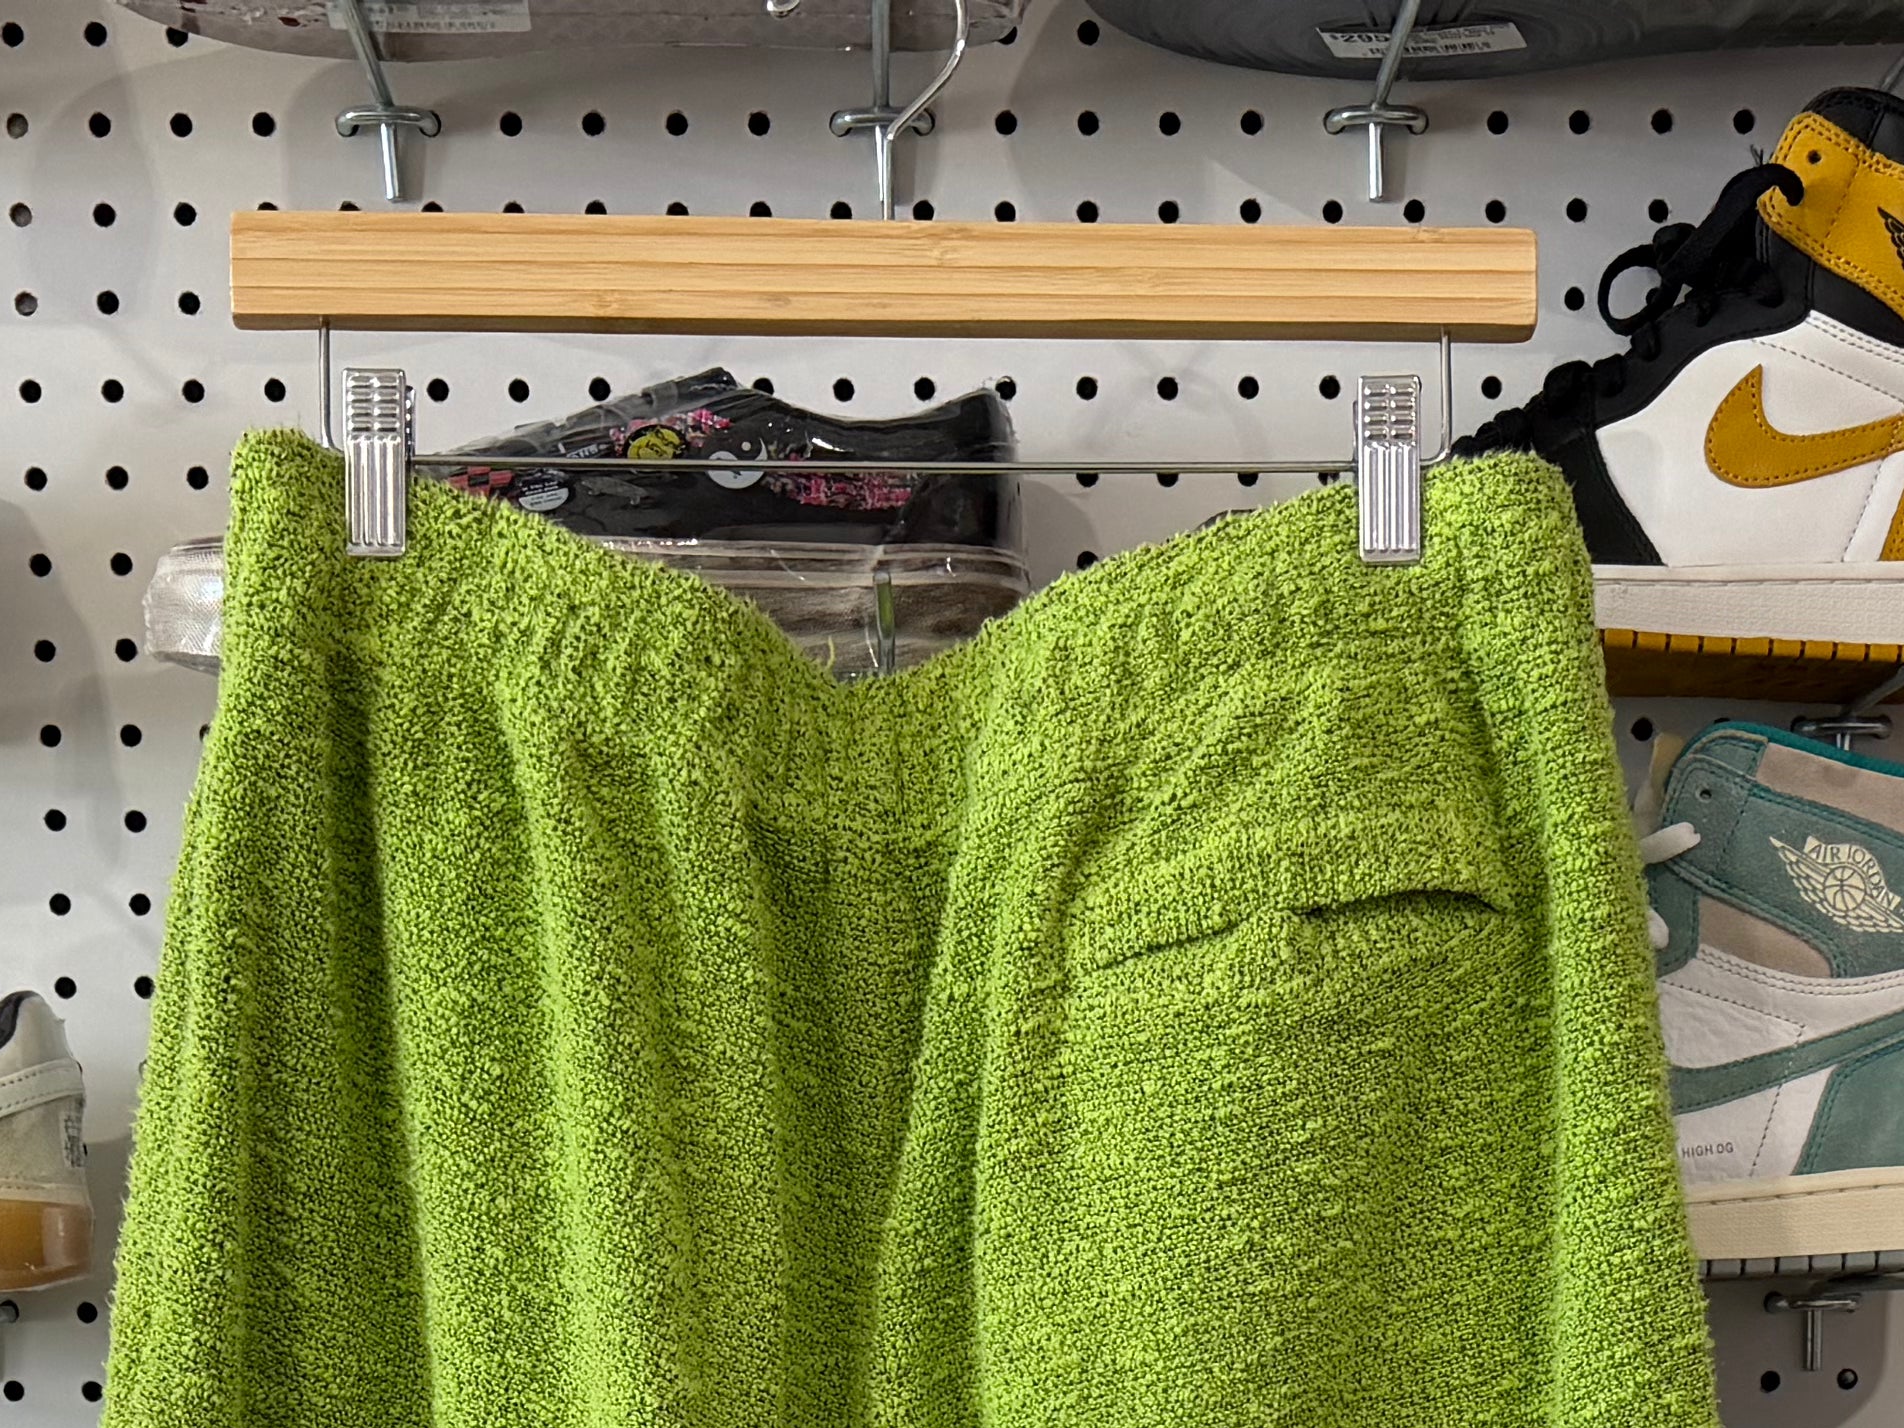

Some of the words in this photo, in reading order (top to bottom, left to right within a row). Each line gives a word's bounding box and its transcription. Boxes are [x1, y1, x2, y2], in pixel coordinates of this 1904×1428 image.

[1807, 843, 1842, 862] AIR
[1846, 843, 1897, 908] JORDAN
[1681, 1144, 1714, 1158] HIGH
[1716, 1141, 1734, 1154] OG
